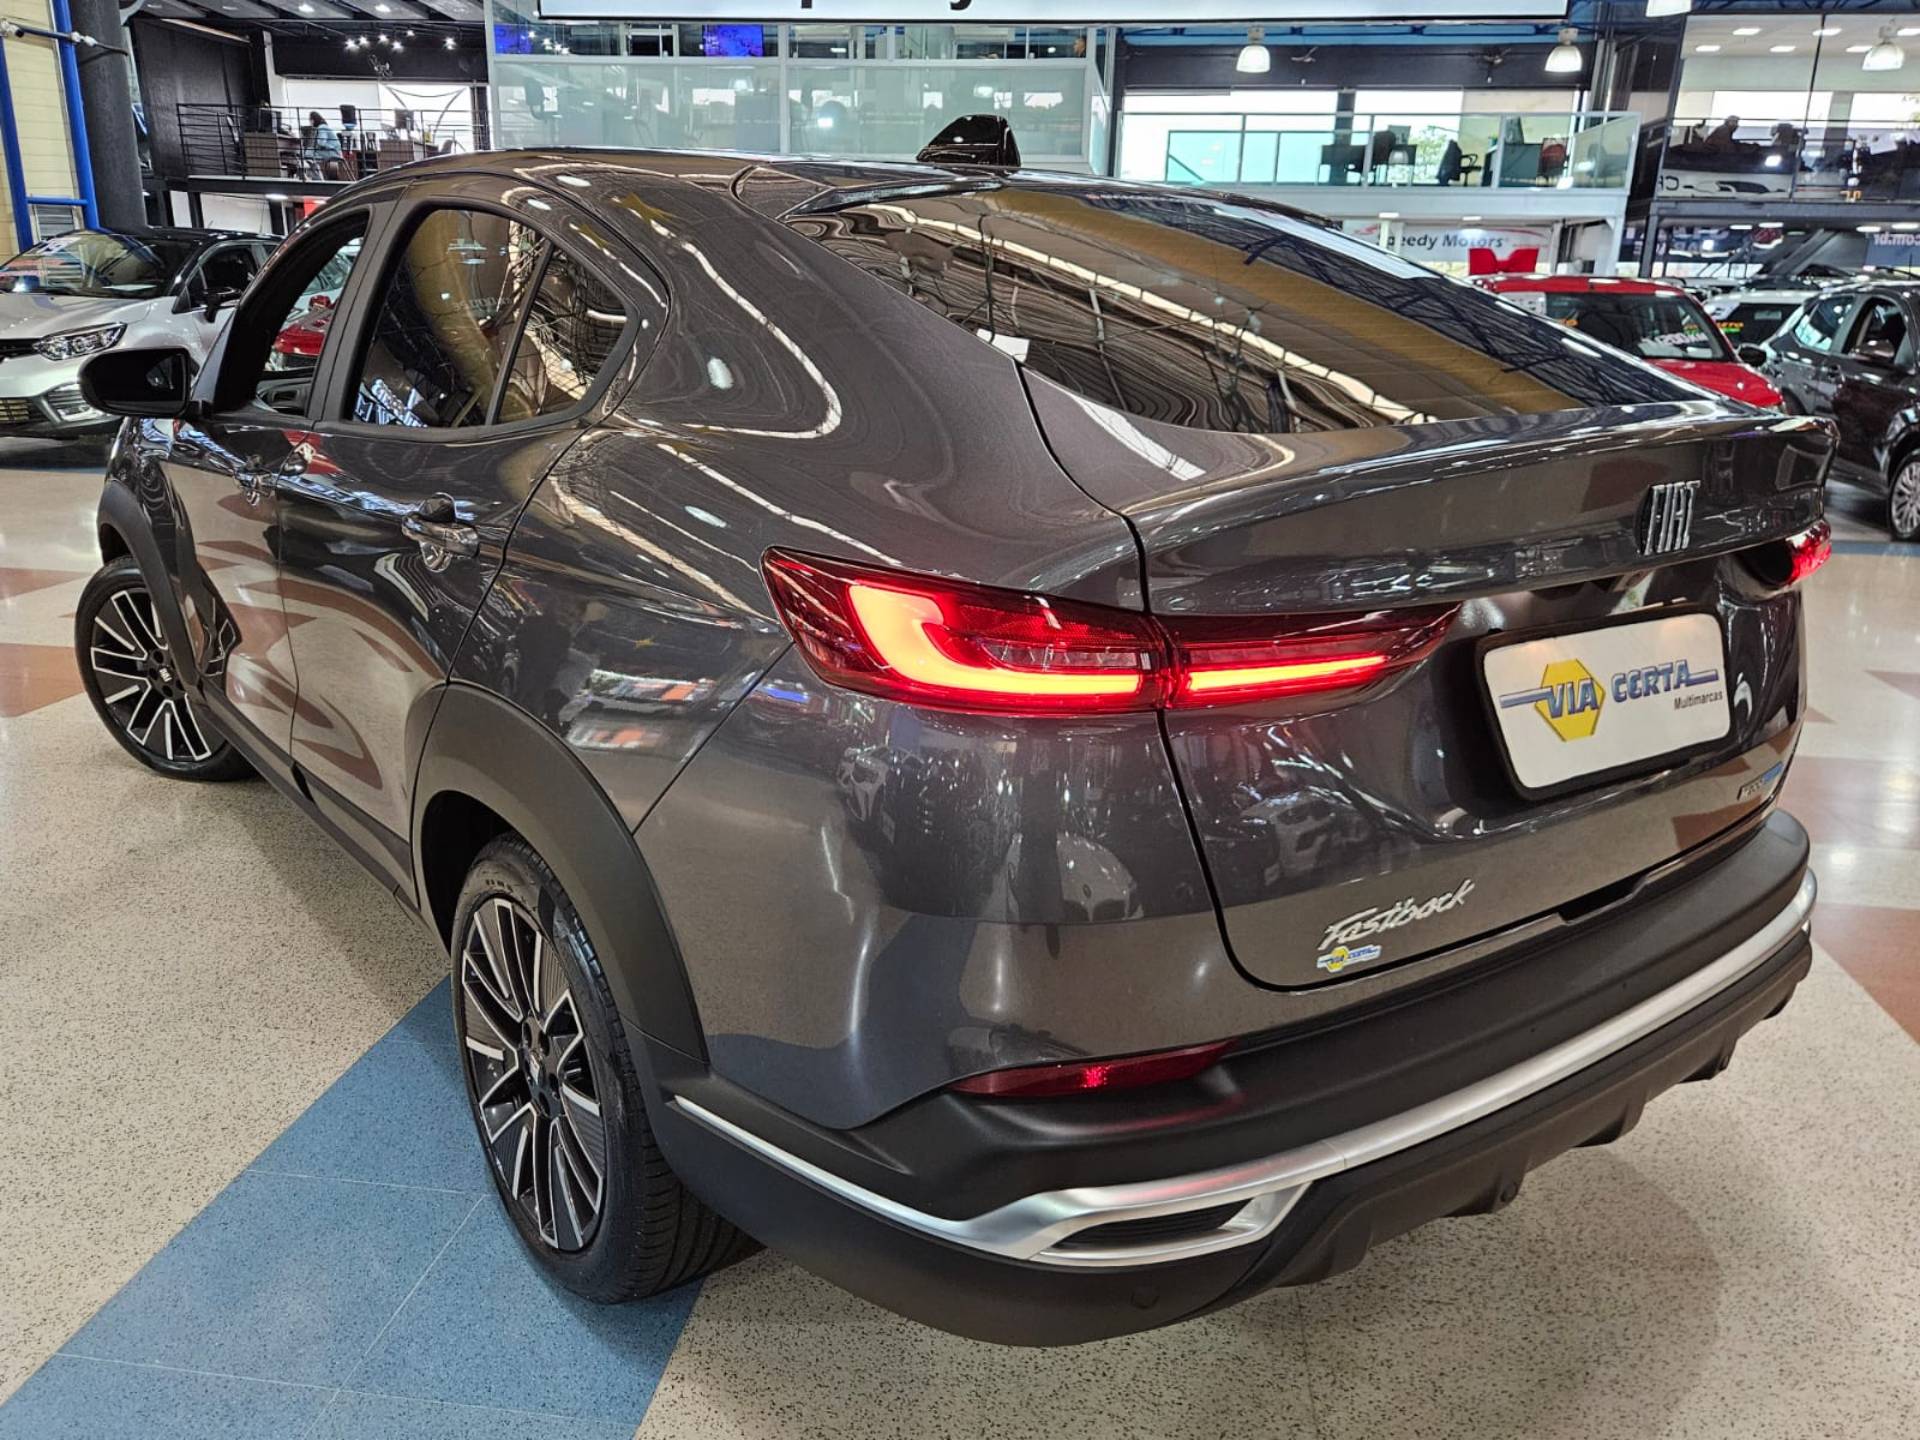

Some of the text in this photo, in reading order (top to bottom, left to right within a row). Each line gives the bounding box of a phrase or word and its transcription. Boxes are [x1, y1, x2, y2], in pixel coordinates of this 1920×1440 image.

[1644, 480, 1701, 556] FIAT
[1548, 659, 1691, 719] VIA CERTA
[1674, 690, 1723, 710] Multimarcas
[1317, 879, 1475, 950] Fastback
